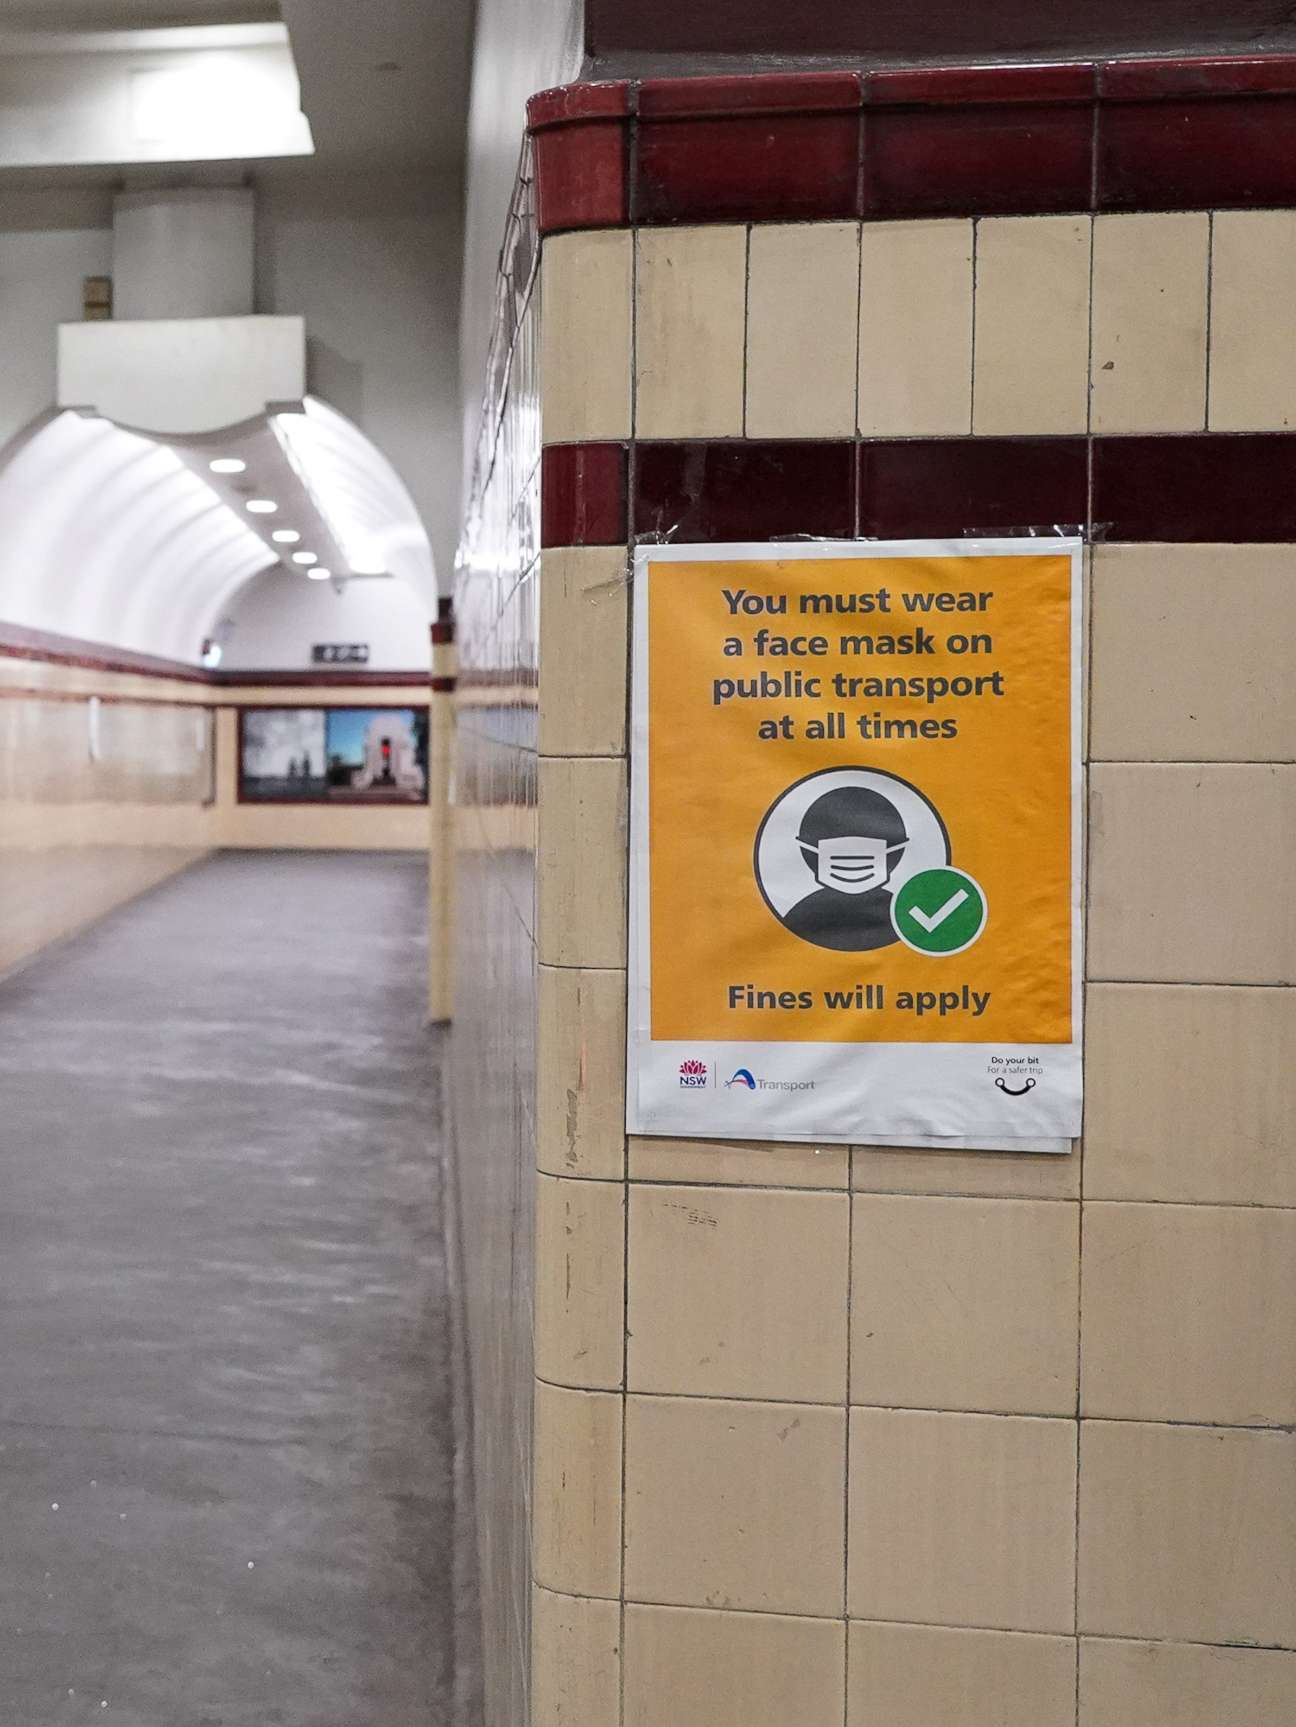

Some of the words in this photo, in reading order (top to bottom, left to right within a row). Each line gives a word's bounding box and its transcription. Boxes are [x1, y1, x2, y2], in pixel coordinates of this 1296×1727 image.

[721, 589, 787, 615] You
[799, 588, 891, 614] must
[902, 591, 994, 613] wear
[723, 637, 743, 657] a
[754, 629, 829, 657] face
[840, 627, 936, 656] mask
[947, 634, 993, 655] on
[713, 671, 822, 705] public
[832, 671, 1005, 704] transport
[758, 714, 795, 740] at
[805, 712, 846, 740] all
[857, 712, 958, 740] times
[728, 984, 813, 1010] Fines
[824, 984, 884, 1010] will
[896, 984, 992, 1017] apply
[987, 1066, 1000, 1074] For
[1009, 1066, 1027, 1074] safer
[1029, 1066, 1043, 1075] trip
[991, 1056, 1004, 1064] Do
[1006, 1057, 1025, 1066] your
[1028, 1056, 1039, 1064] bit
[679, 1076, 707, 1086] NSW
[757, 1079, 816, 1092] Transport
